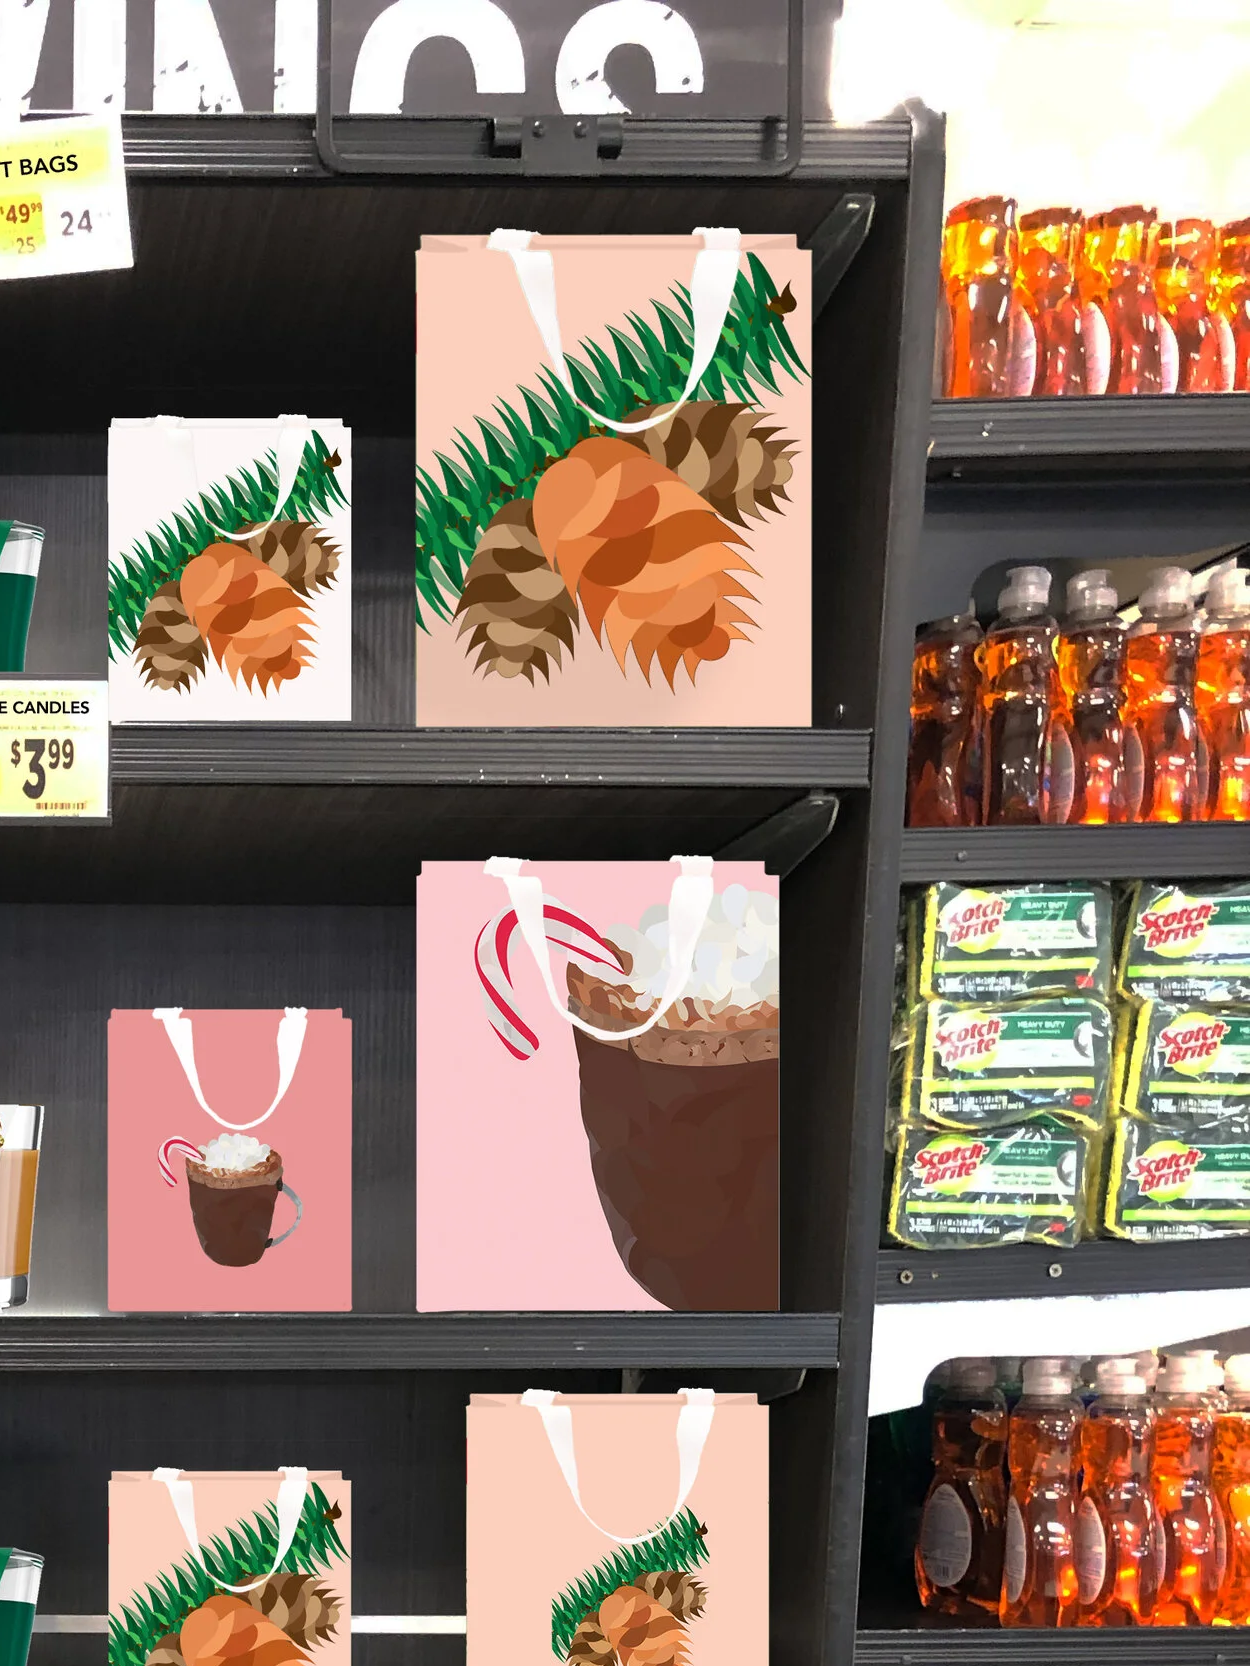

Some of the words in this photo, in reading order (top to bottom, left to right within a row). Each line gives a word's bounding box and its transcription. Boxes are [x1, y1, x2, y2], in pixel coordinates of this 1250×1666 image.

[20, 154, 79, 176] BAGS
[12, 700, 90, 714] CANDLES
[1147, 922, 1205, 948] Brite
[1167, 1041, 1218, 1065] Brite
[923, 1161, 977, 1185] Brite
[1141, 1167, 1192, 1193] Brite
